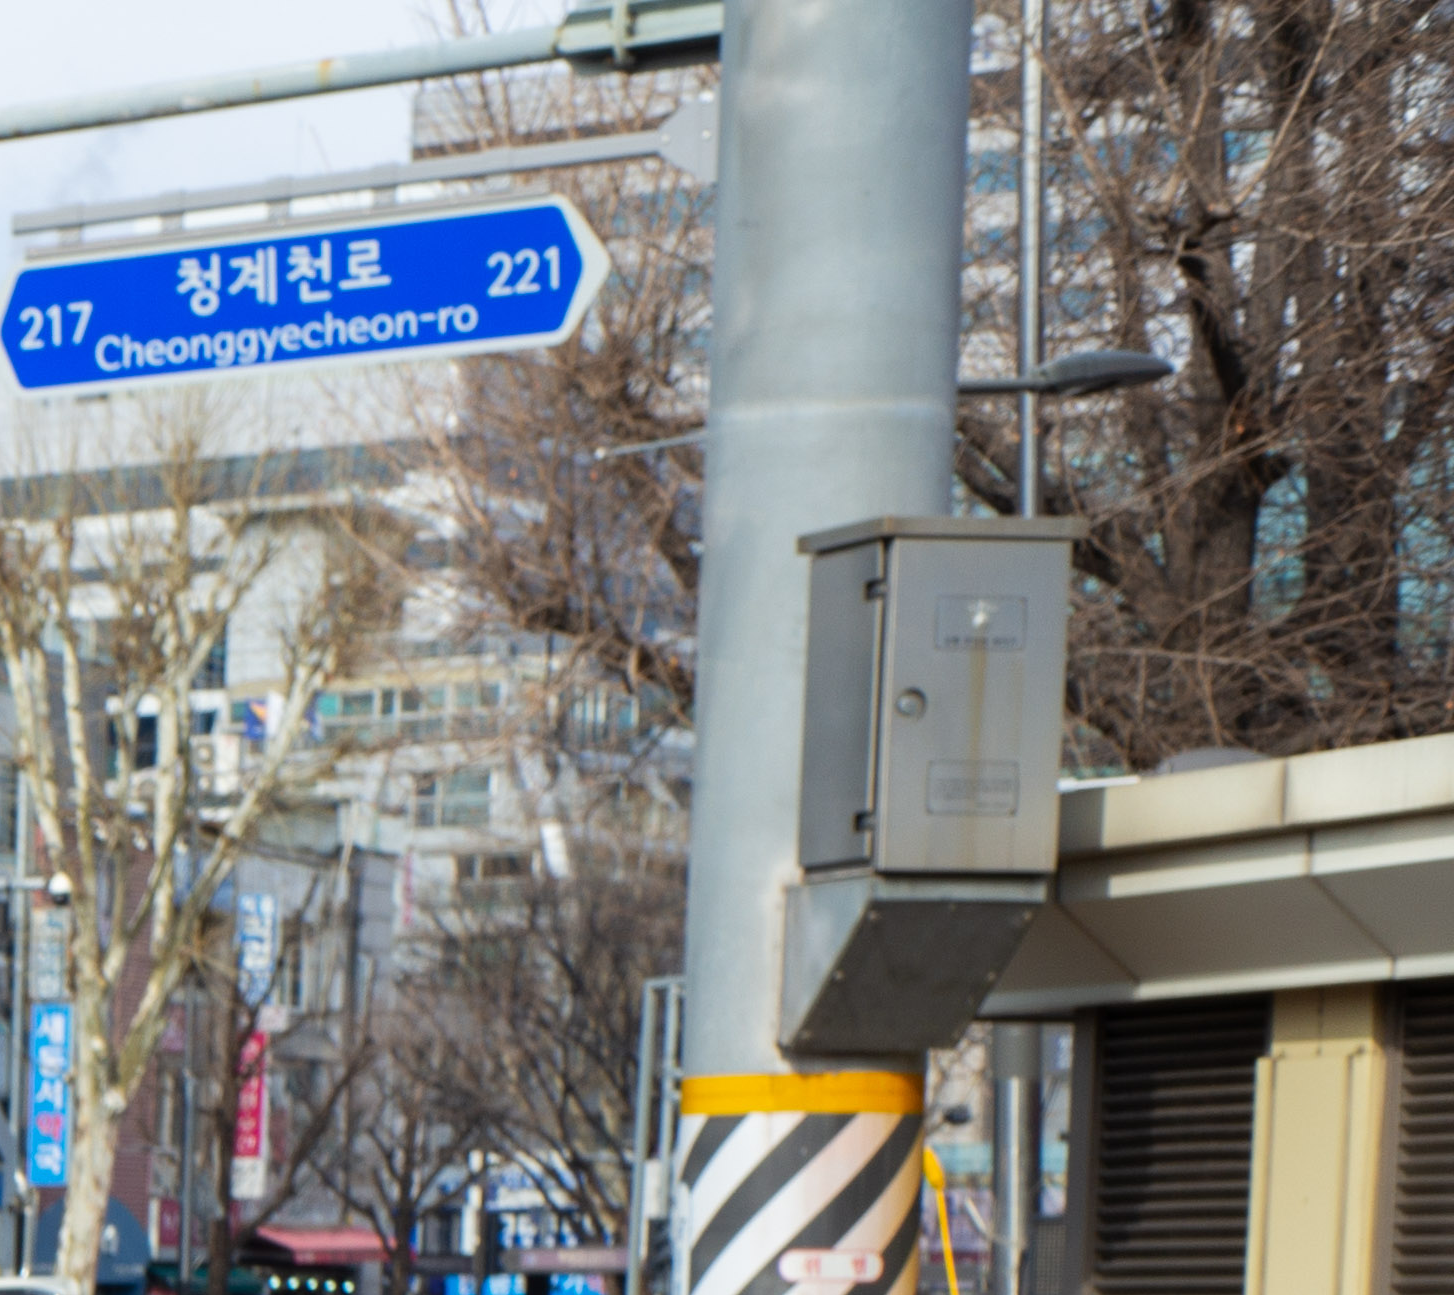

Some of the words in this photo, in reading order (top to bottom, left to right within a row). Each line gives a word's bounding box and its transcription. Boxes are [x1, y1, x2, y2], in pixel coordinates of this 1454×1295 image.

[176, 238, 392, 318] 청계천로
[485, 245, 562, 299] 221
[18, 301, 93, 352] 217
[94, 304, 479, 372] Cheonggyecheon-ro
